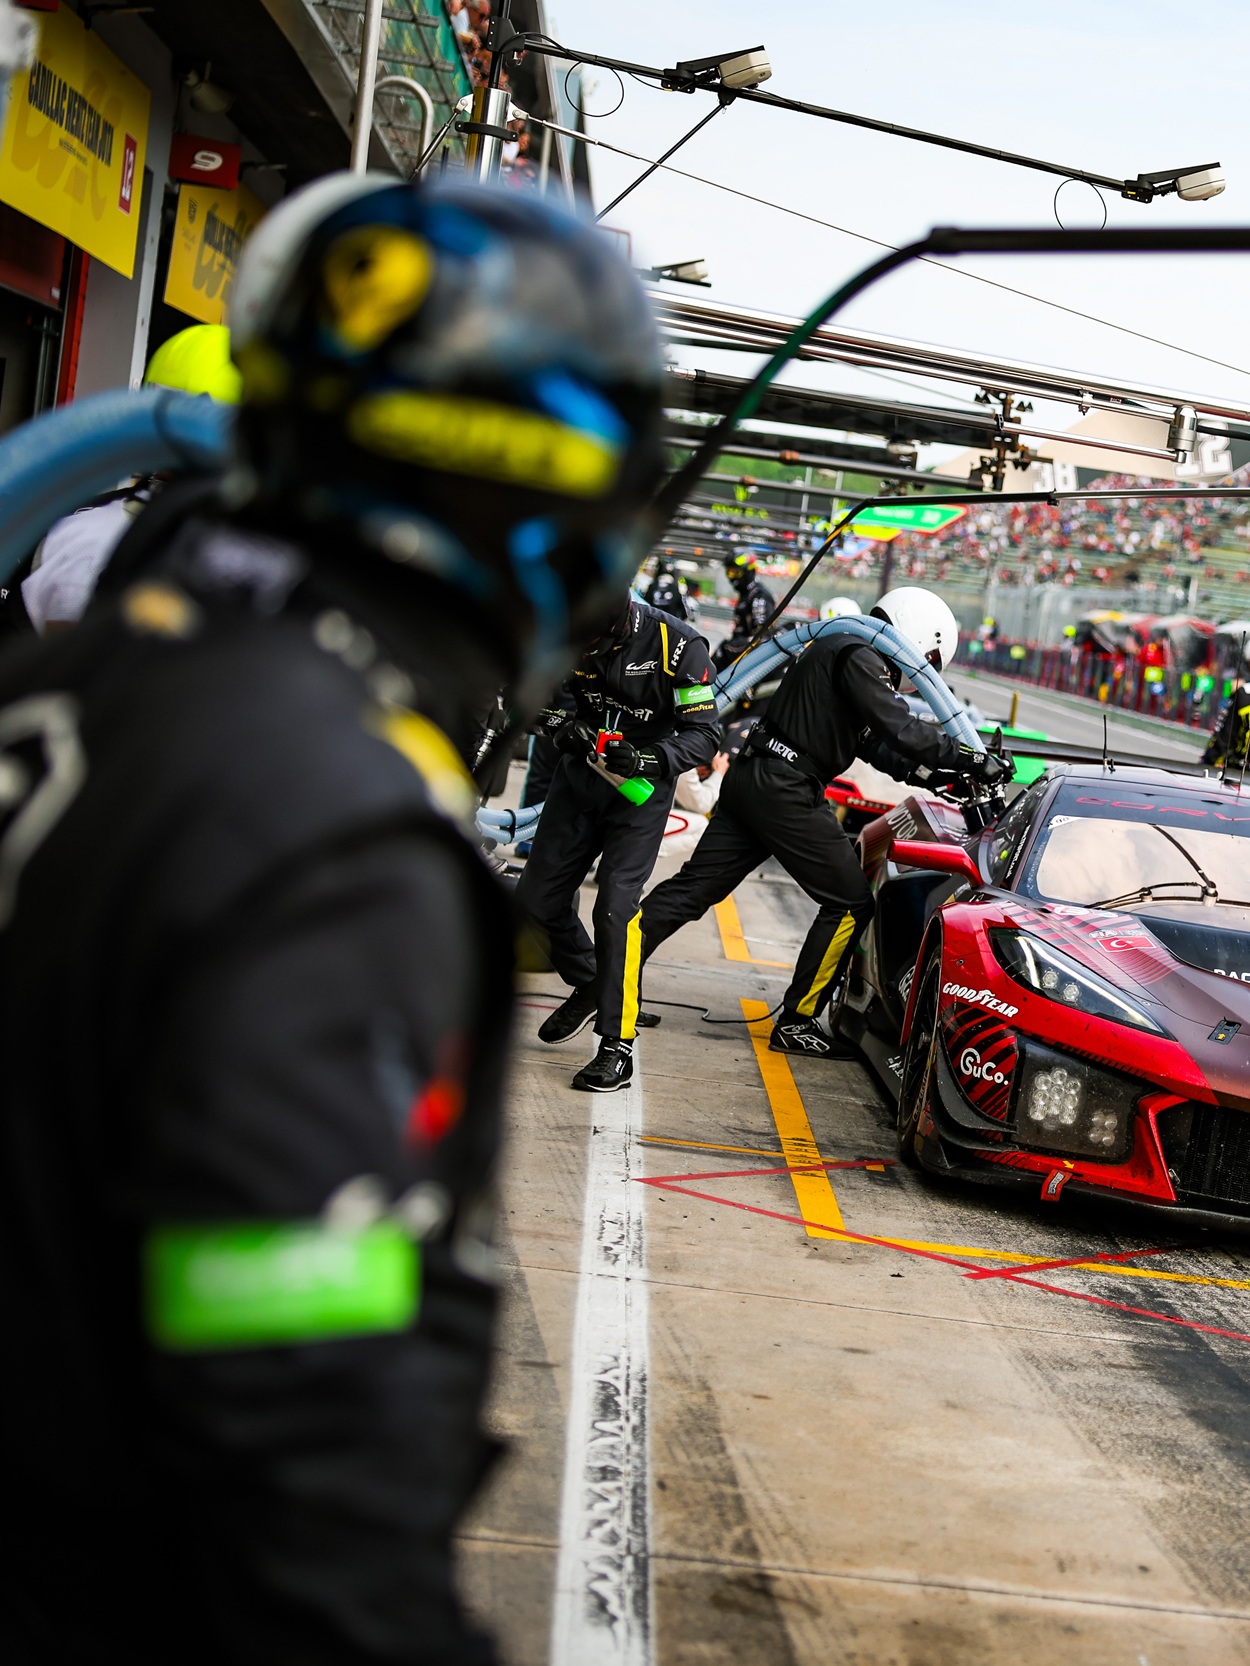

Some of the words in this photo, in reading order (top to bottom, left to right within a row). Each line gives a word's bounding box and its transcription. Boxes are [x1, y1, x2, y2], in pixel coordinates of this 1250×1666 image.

[190, 150, 223, 172] 9
[626, 660, 658, 670] WEC
[886, 804, 918, 840] MOTOR
[943, 982, 1019, 1018] GOODYEAR
